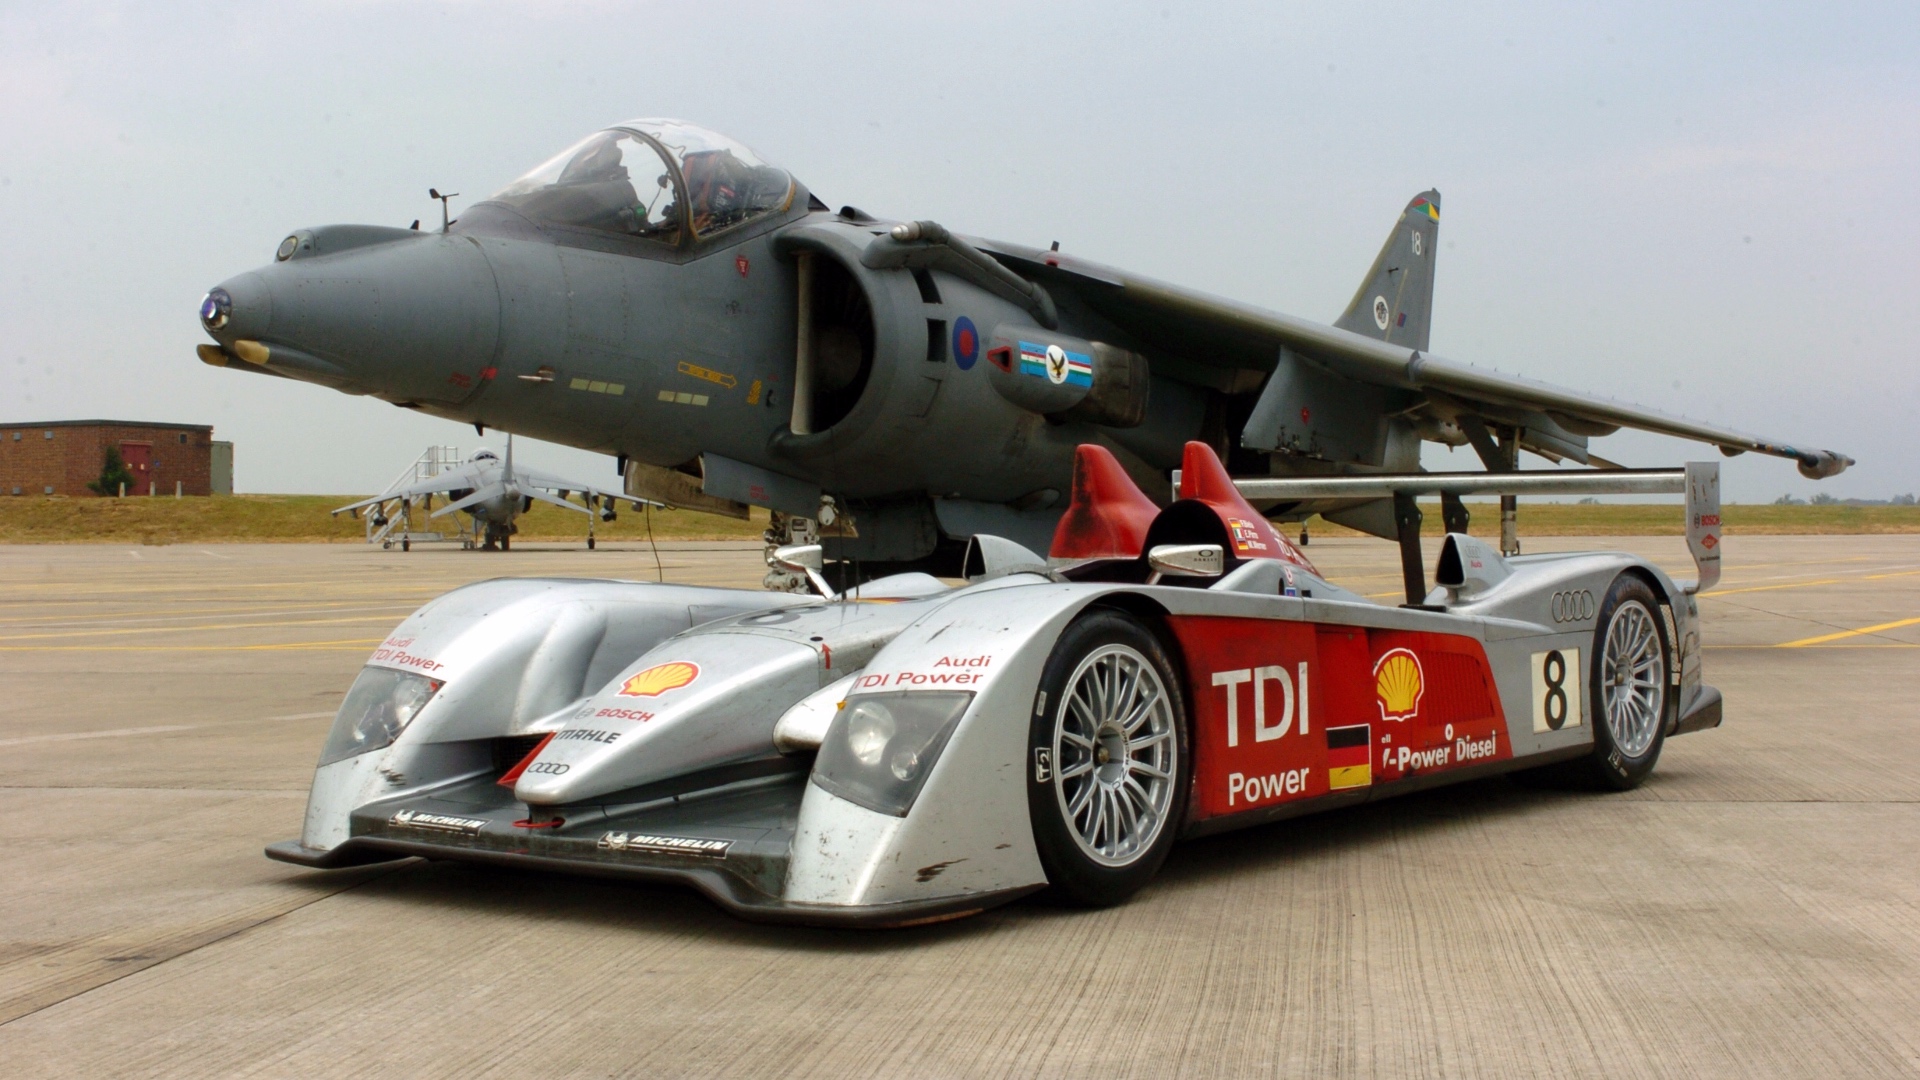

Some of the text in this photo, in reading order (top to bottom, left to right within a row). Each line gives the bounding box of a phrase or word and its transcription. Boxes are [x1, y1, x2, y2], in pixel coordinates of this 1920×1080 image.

[1411, 229, 1422, 256] 18
[383, 636, 416, 648] Audi
[391, 650, 445, 672] Power
[933, 655, 993, 668] Audi
[853, 672, 984, 690] TDI Power
[1543, 649, 1567, 731] 8
[1211, 661, 1309, 748] TDI
[595, 708, 655, 722] BOSCH
[554, 729, 622, 745] MAHLE
[1456, 729, 1496, 761] Diesel
[1036, 750, 1051, 780] T2
[1228, 767, 1310, 806] Power
[414, 813, 487, 829] MICHELIN
[631, 834, 729, 851] MICHELIN
